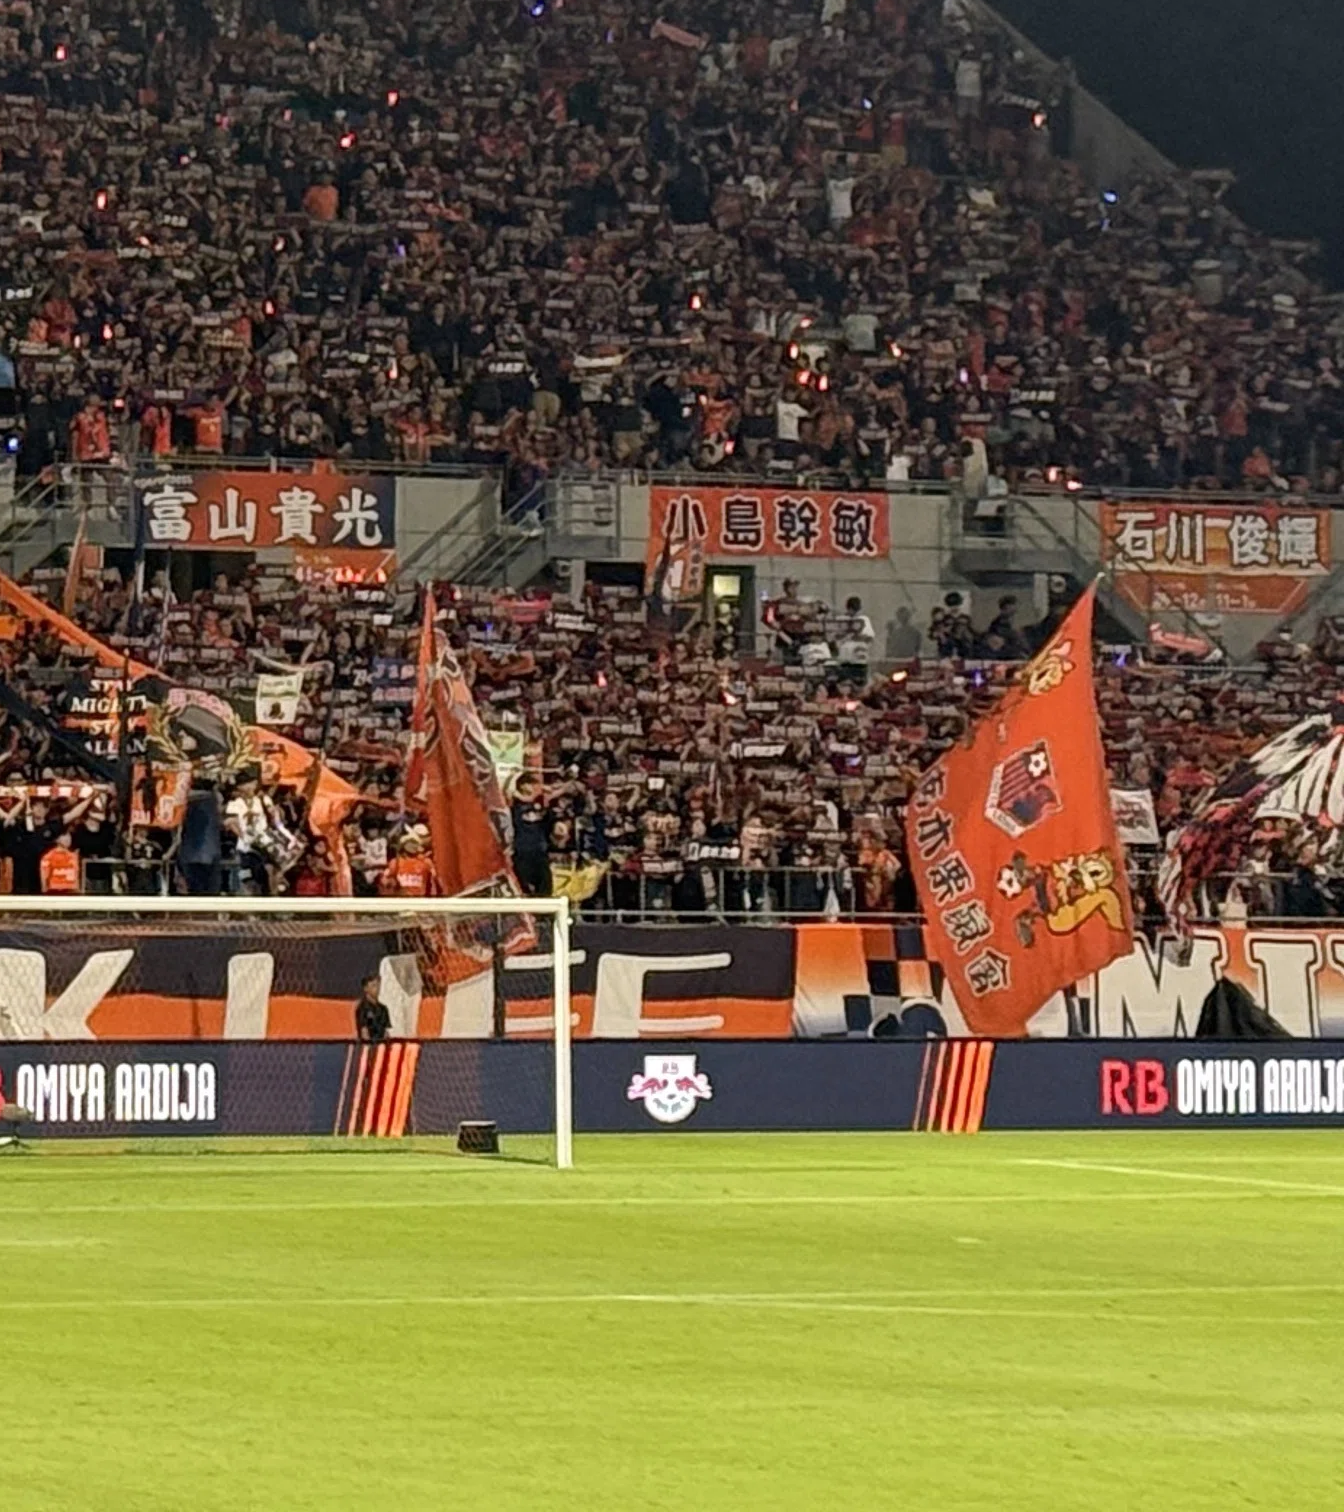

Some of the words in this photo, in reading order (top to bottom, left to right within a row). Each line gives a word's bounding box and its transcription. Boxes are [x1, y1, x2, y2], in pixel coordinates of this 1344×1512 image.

[143, 484, 384, 548] 富山貴光
[662, 493, 879, 557] 小島幹敏
[1115, 510, 1319, 569] 石川俊輝
[16, 1062, 106, 1122] OMIYA
[114, 1062, 217, 1121] ARDIJA
[1100, 1059, 1170, 1115] RB
[1176, 1058, 1257, 1115] OMIYA
